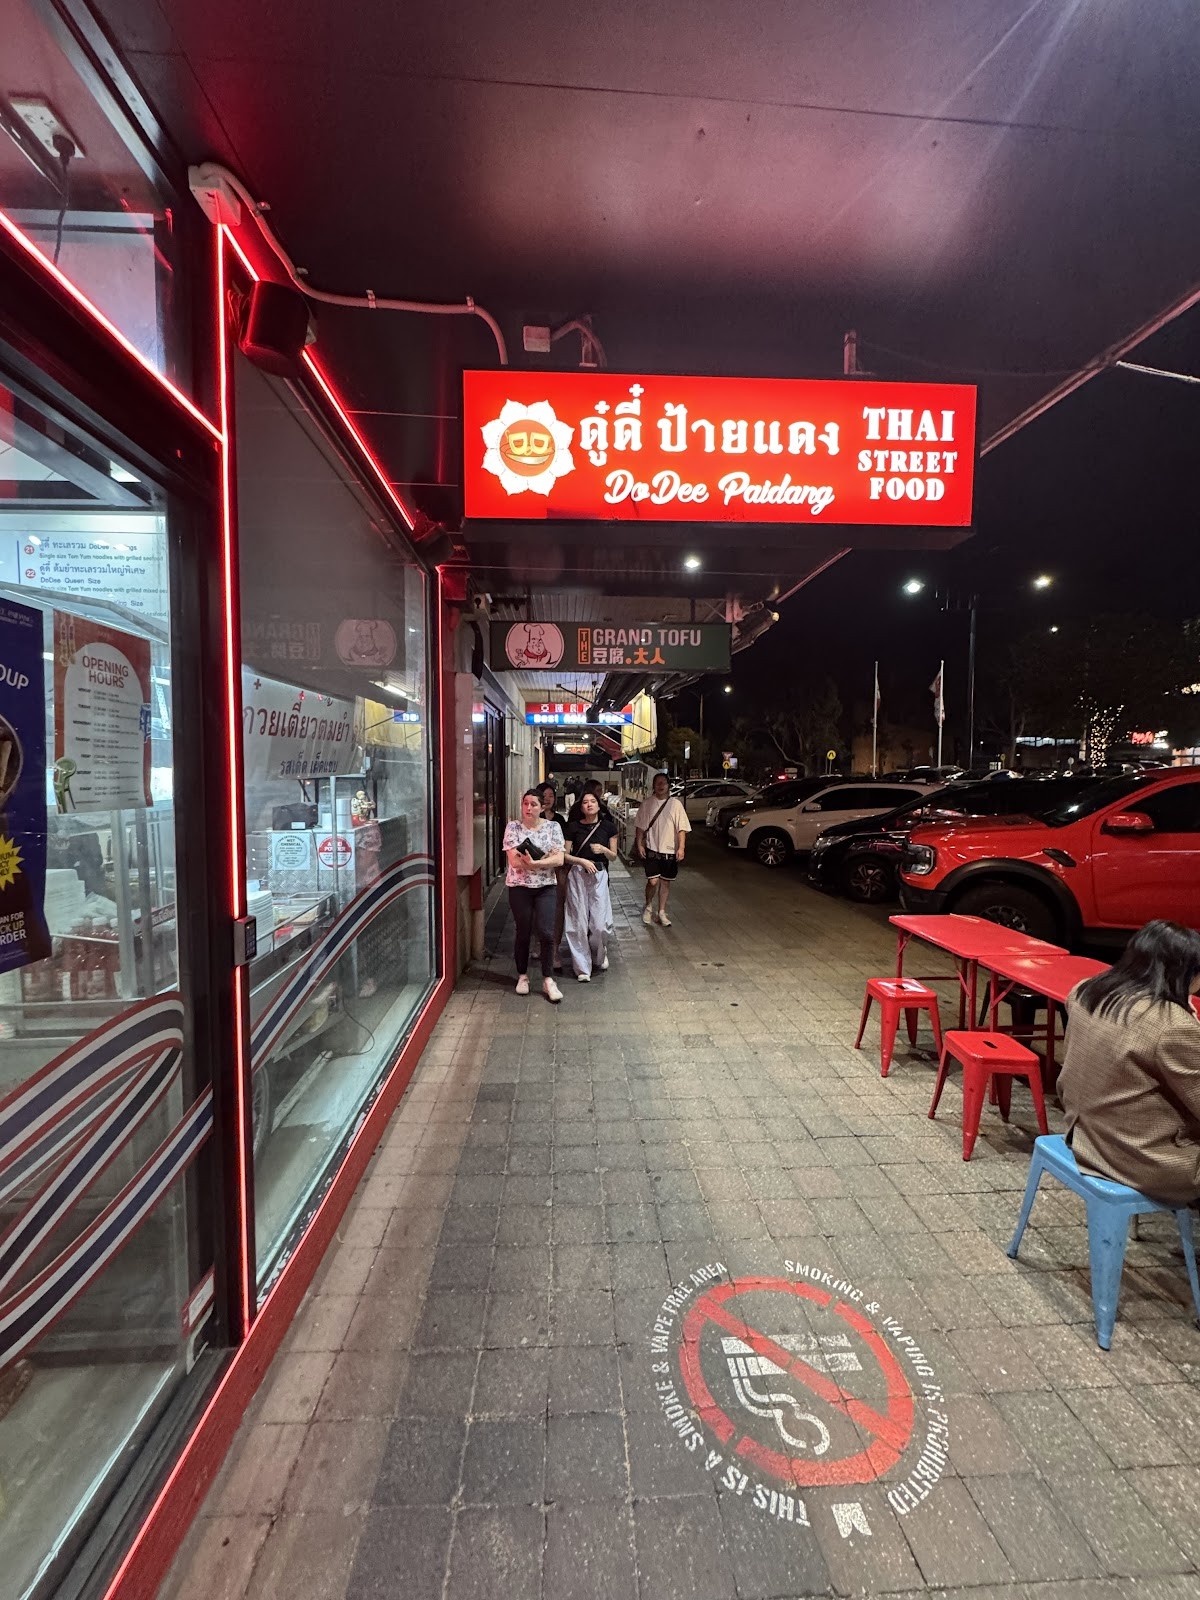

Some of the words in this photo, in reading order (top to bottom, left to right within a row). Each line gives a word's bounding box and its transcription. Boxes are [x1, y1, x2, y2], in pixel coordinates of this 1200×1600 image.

[579, 383, 645, 467] ดู๋ดี๋
[657, 402, 840, 456] ป้ายแดง
[862, 406, 956, 442] THAI
[857, 449, 958, 473] STREET
[603, 469, 709, 505] DoDee
[718, 471, 835, 516] Paidang
[869, 477, 945, 501] FOOD
[25, 546, 35, 554] 21
[593, 628, 653, 646] GRAND
[657, 629, 702, 646] TOFU
[82, 655, 129, 677] OPENING
[89, 670, 125, 688] HOURS
[10, 911, 25, 922] FOR
[12, 920, 25, 931] UP
[689, 1262, 728, 1287] AREA
[784, 1260, 864, 1301] SMOKING
[661, 1281, 693, 1315] FREE
[865, 1301, 880, 1315] &
[651, 1314, 674, 1353] VAPE
[882, 1316, 935, 1376] VAPING
[651, 1361, 670, 1374] &
[922, 1383, 944, 1402] IS
[655, 1380, 704, 1452] SMOKE
[705, 1450, 723, 1471] A
[887, 1408, 949, 1515] PROHIBITED
[720, 1465, 749, 1496] IS
[753, 1483, 811, 1527] THIS
